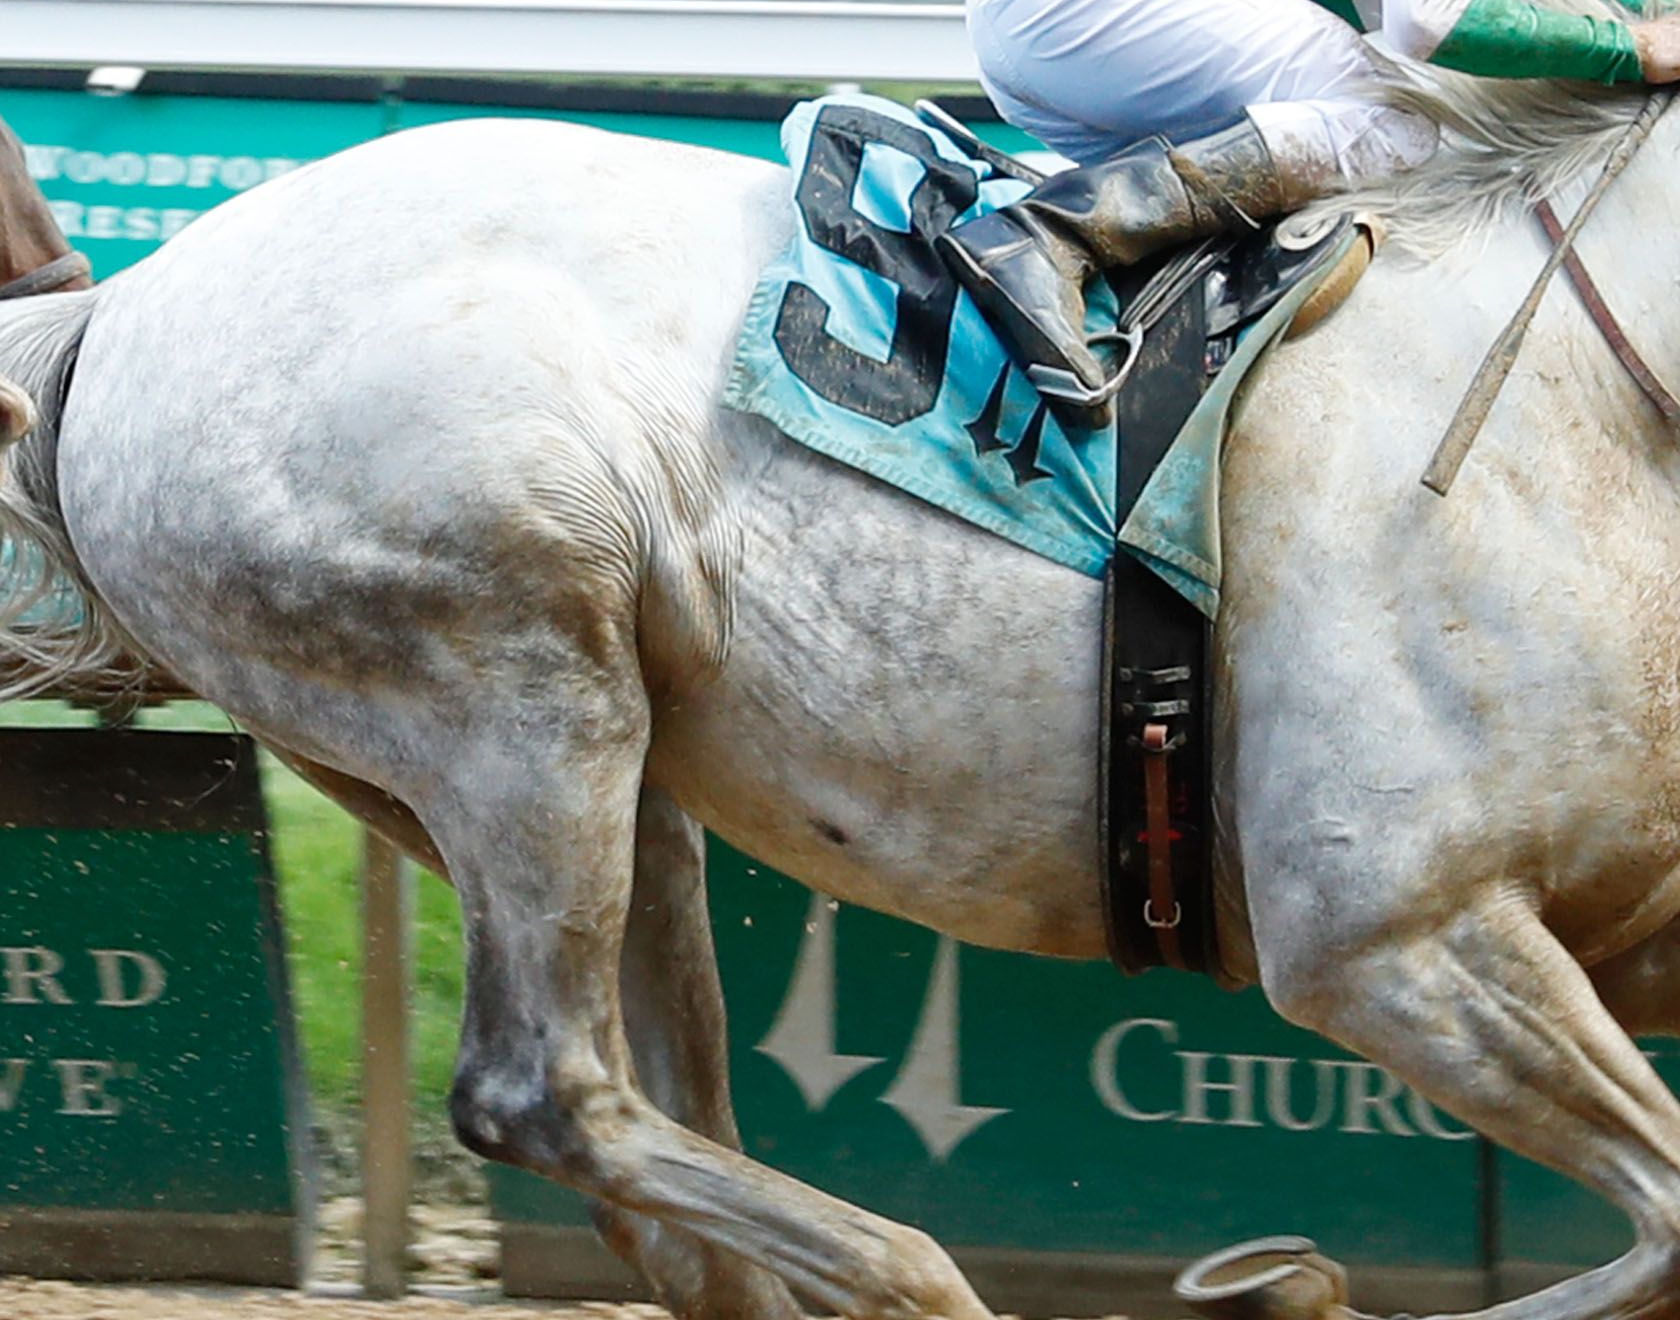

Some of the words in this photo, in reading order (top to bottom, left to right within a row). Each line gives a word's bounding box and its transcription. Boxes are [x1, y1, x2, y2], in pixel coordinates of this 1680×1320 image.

[23, 144, 310, 191] WOODFO
[45, 199, 205, 241] RESE
[772, 103, 980, 428] 9
